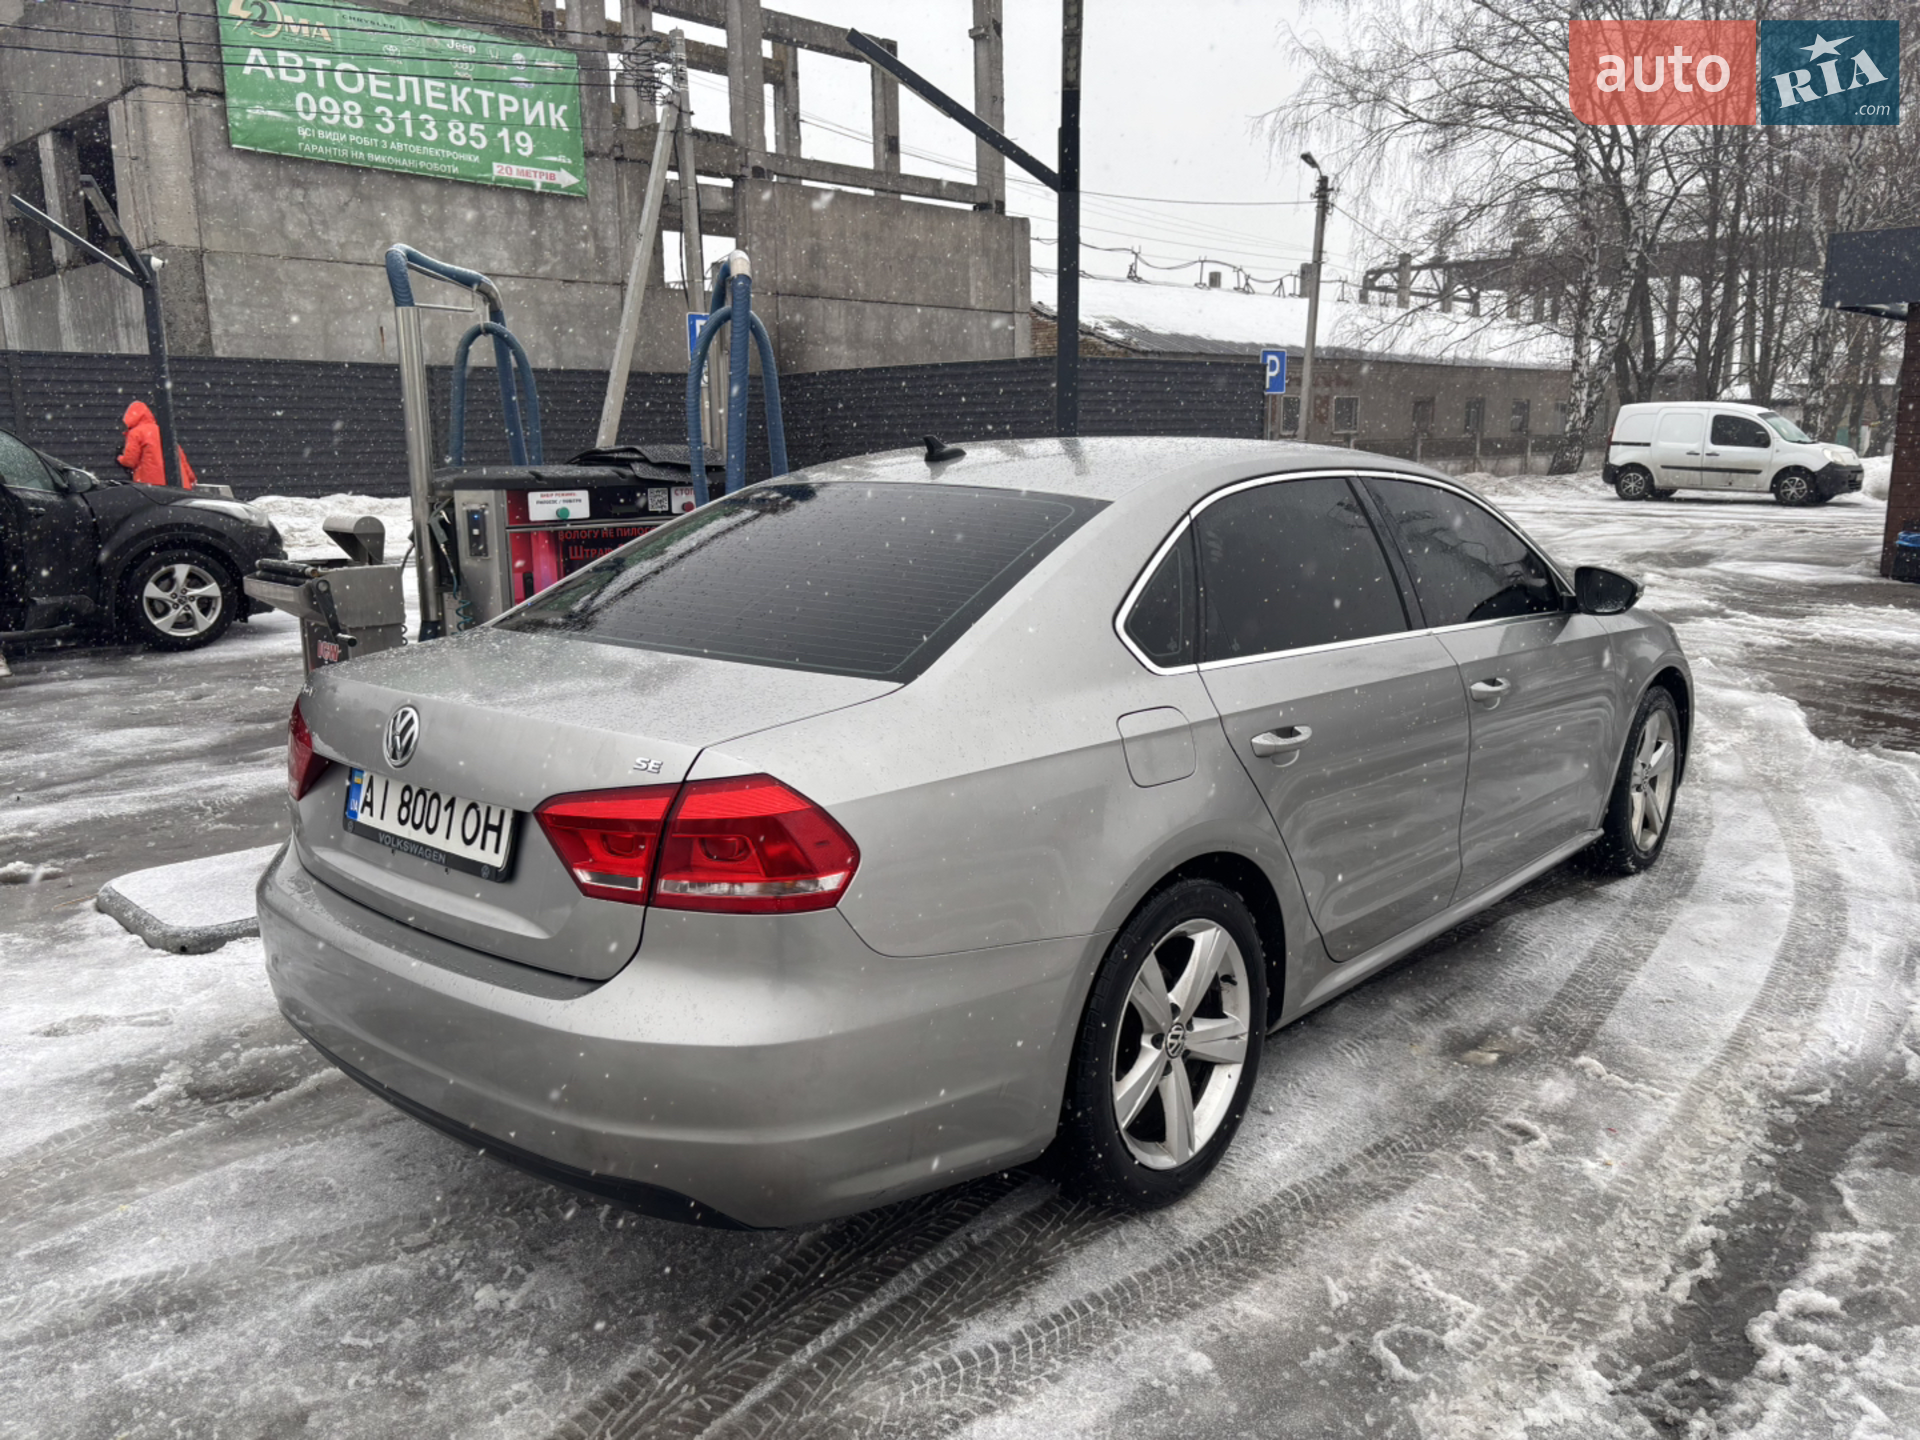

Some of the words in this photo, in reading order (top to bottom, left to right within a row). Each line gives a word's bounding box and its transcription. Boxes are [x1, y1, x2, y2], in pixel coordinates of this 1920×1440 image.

[447, 39, 477, 54] Jeep
[243, 48, 569, 131] АВТОЕЛЕКТРИК
[295, 92, 364, 129] 098
[374, 106, 438, 141] 313
[448, 120, 487, 149] 85
[497, 128, 534, 156] 19
[297, 126, 315, 138] ВСІ
[318, 129, 347, 142] ВИДИ
[349, 134, 378, 147] РОБІТ
[298, 142, 348, 158] ГАРАНТІЯ
[351, 150, 365, 160] НА
[419, 161, 459, 174] РОБОТИ
[497, 165, 513, 176] 20
[516, 168, 556, 181] МЕТРІВ
[1265, 354, 1280, 389] P
[558, 529, 600, 540] ВОЛОГУ
[602, 528, 614, 539] НЕ
[633, 757, 663, 774] SE
[360, 774, 389, 821] AI
[397, 784, 457, 841] 8001
[462, 802, 506, 855] OH
[378, 832, 447, 864] VOLKSWAGEN
